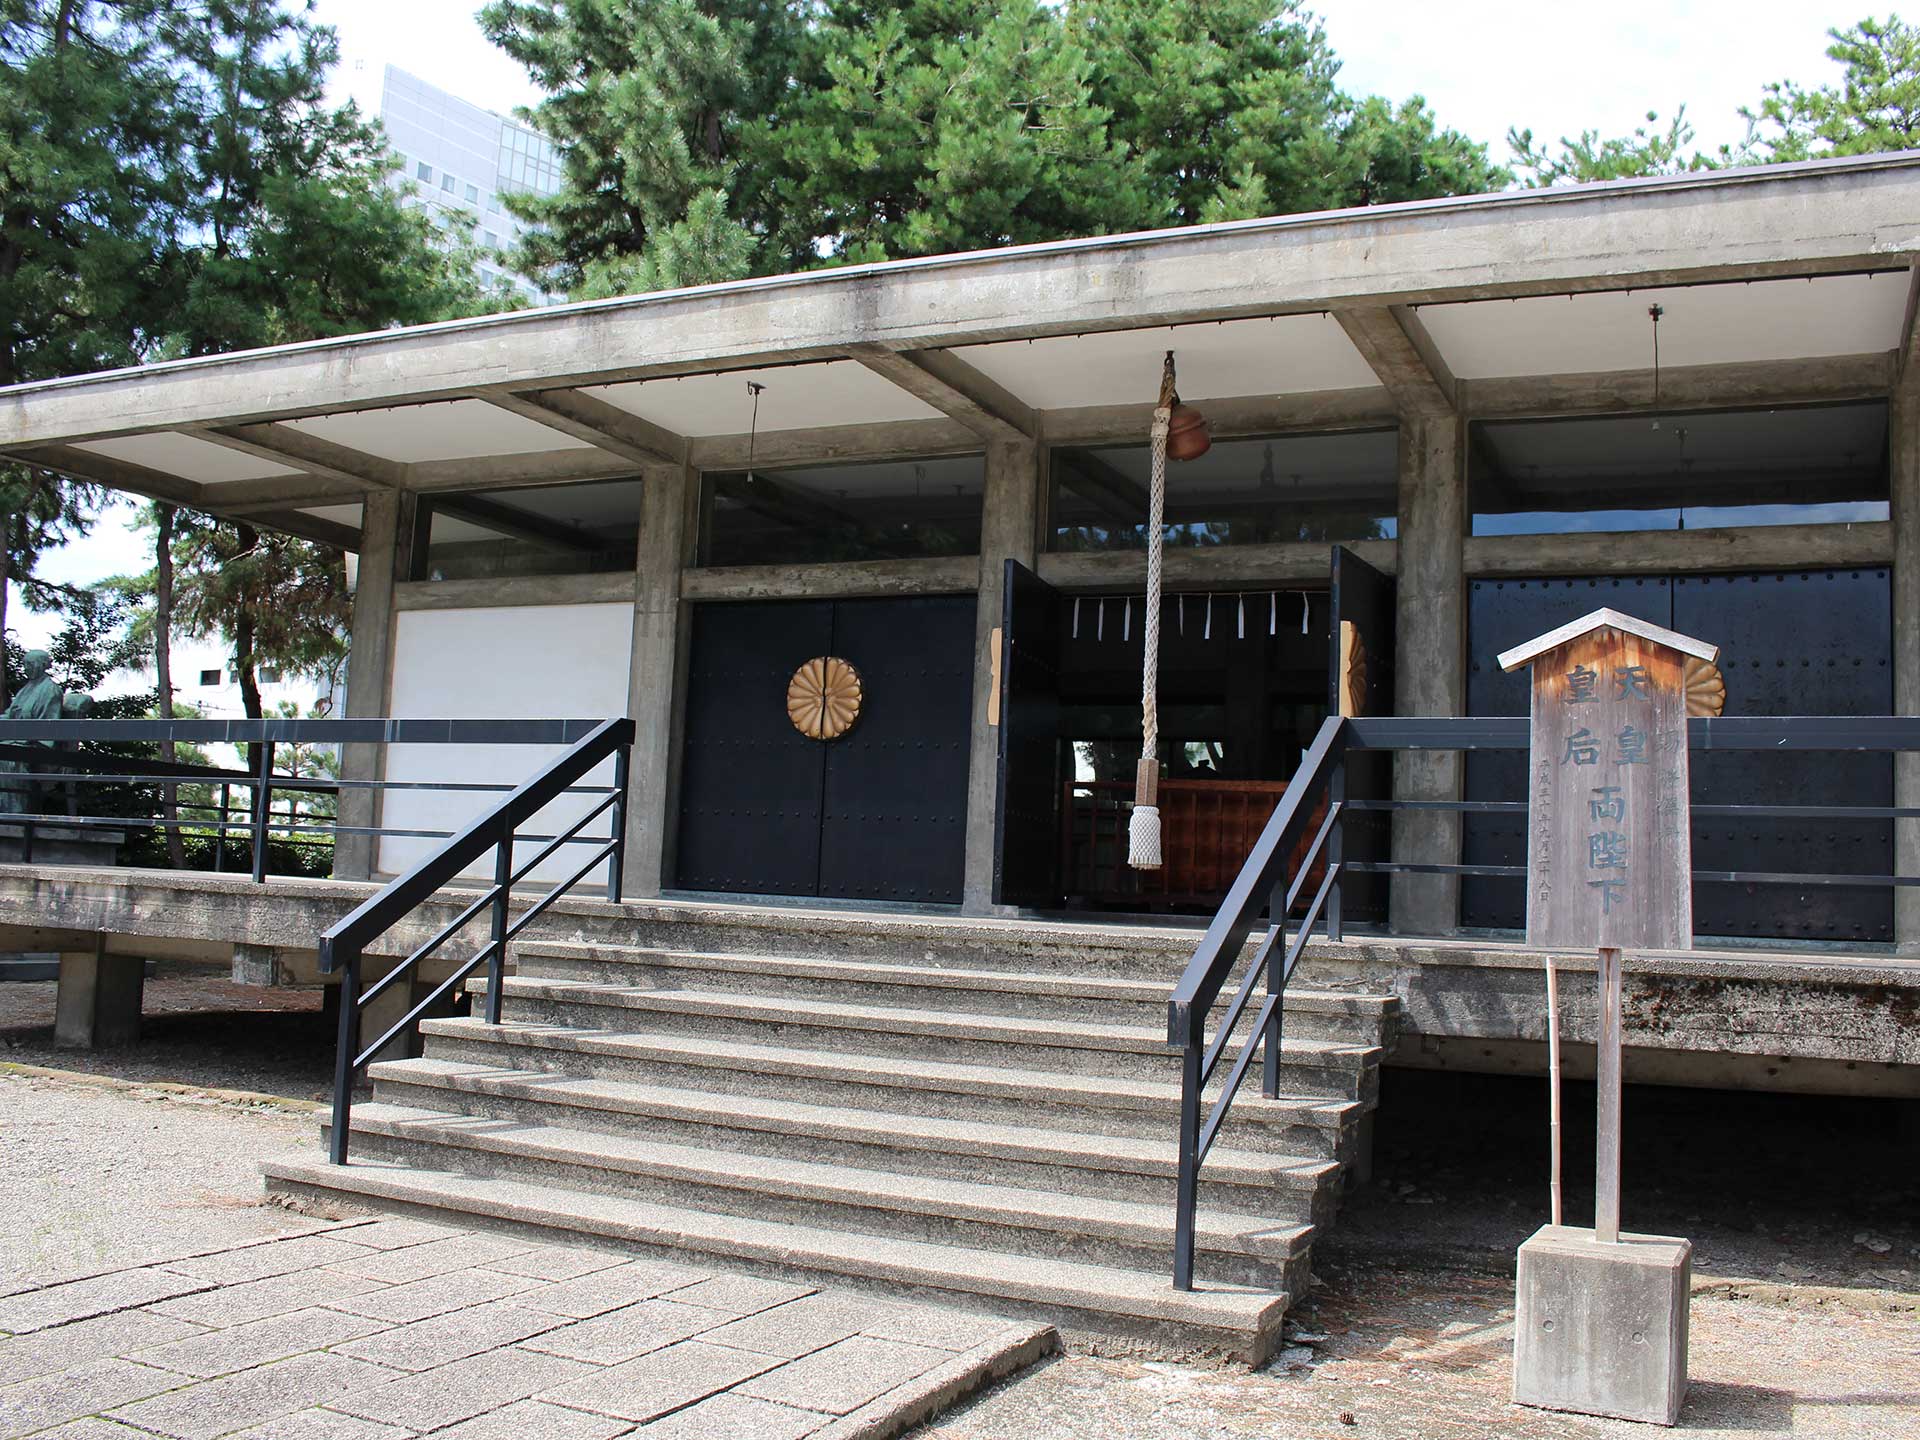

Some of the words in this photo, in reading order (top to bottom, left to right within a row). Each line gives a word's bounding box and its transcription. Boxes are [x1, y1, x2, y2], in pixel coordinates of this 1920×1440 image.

[1560, 664, 1601, 767] 皇后
[1613, 665, 1650, 766] 天皇
[1587, 786, 1629, 915] 両陛下
